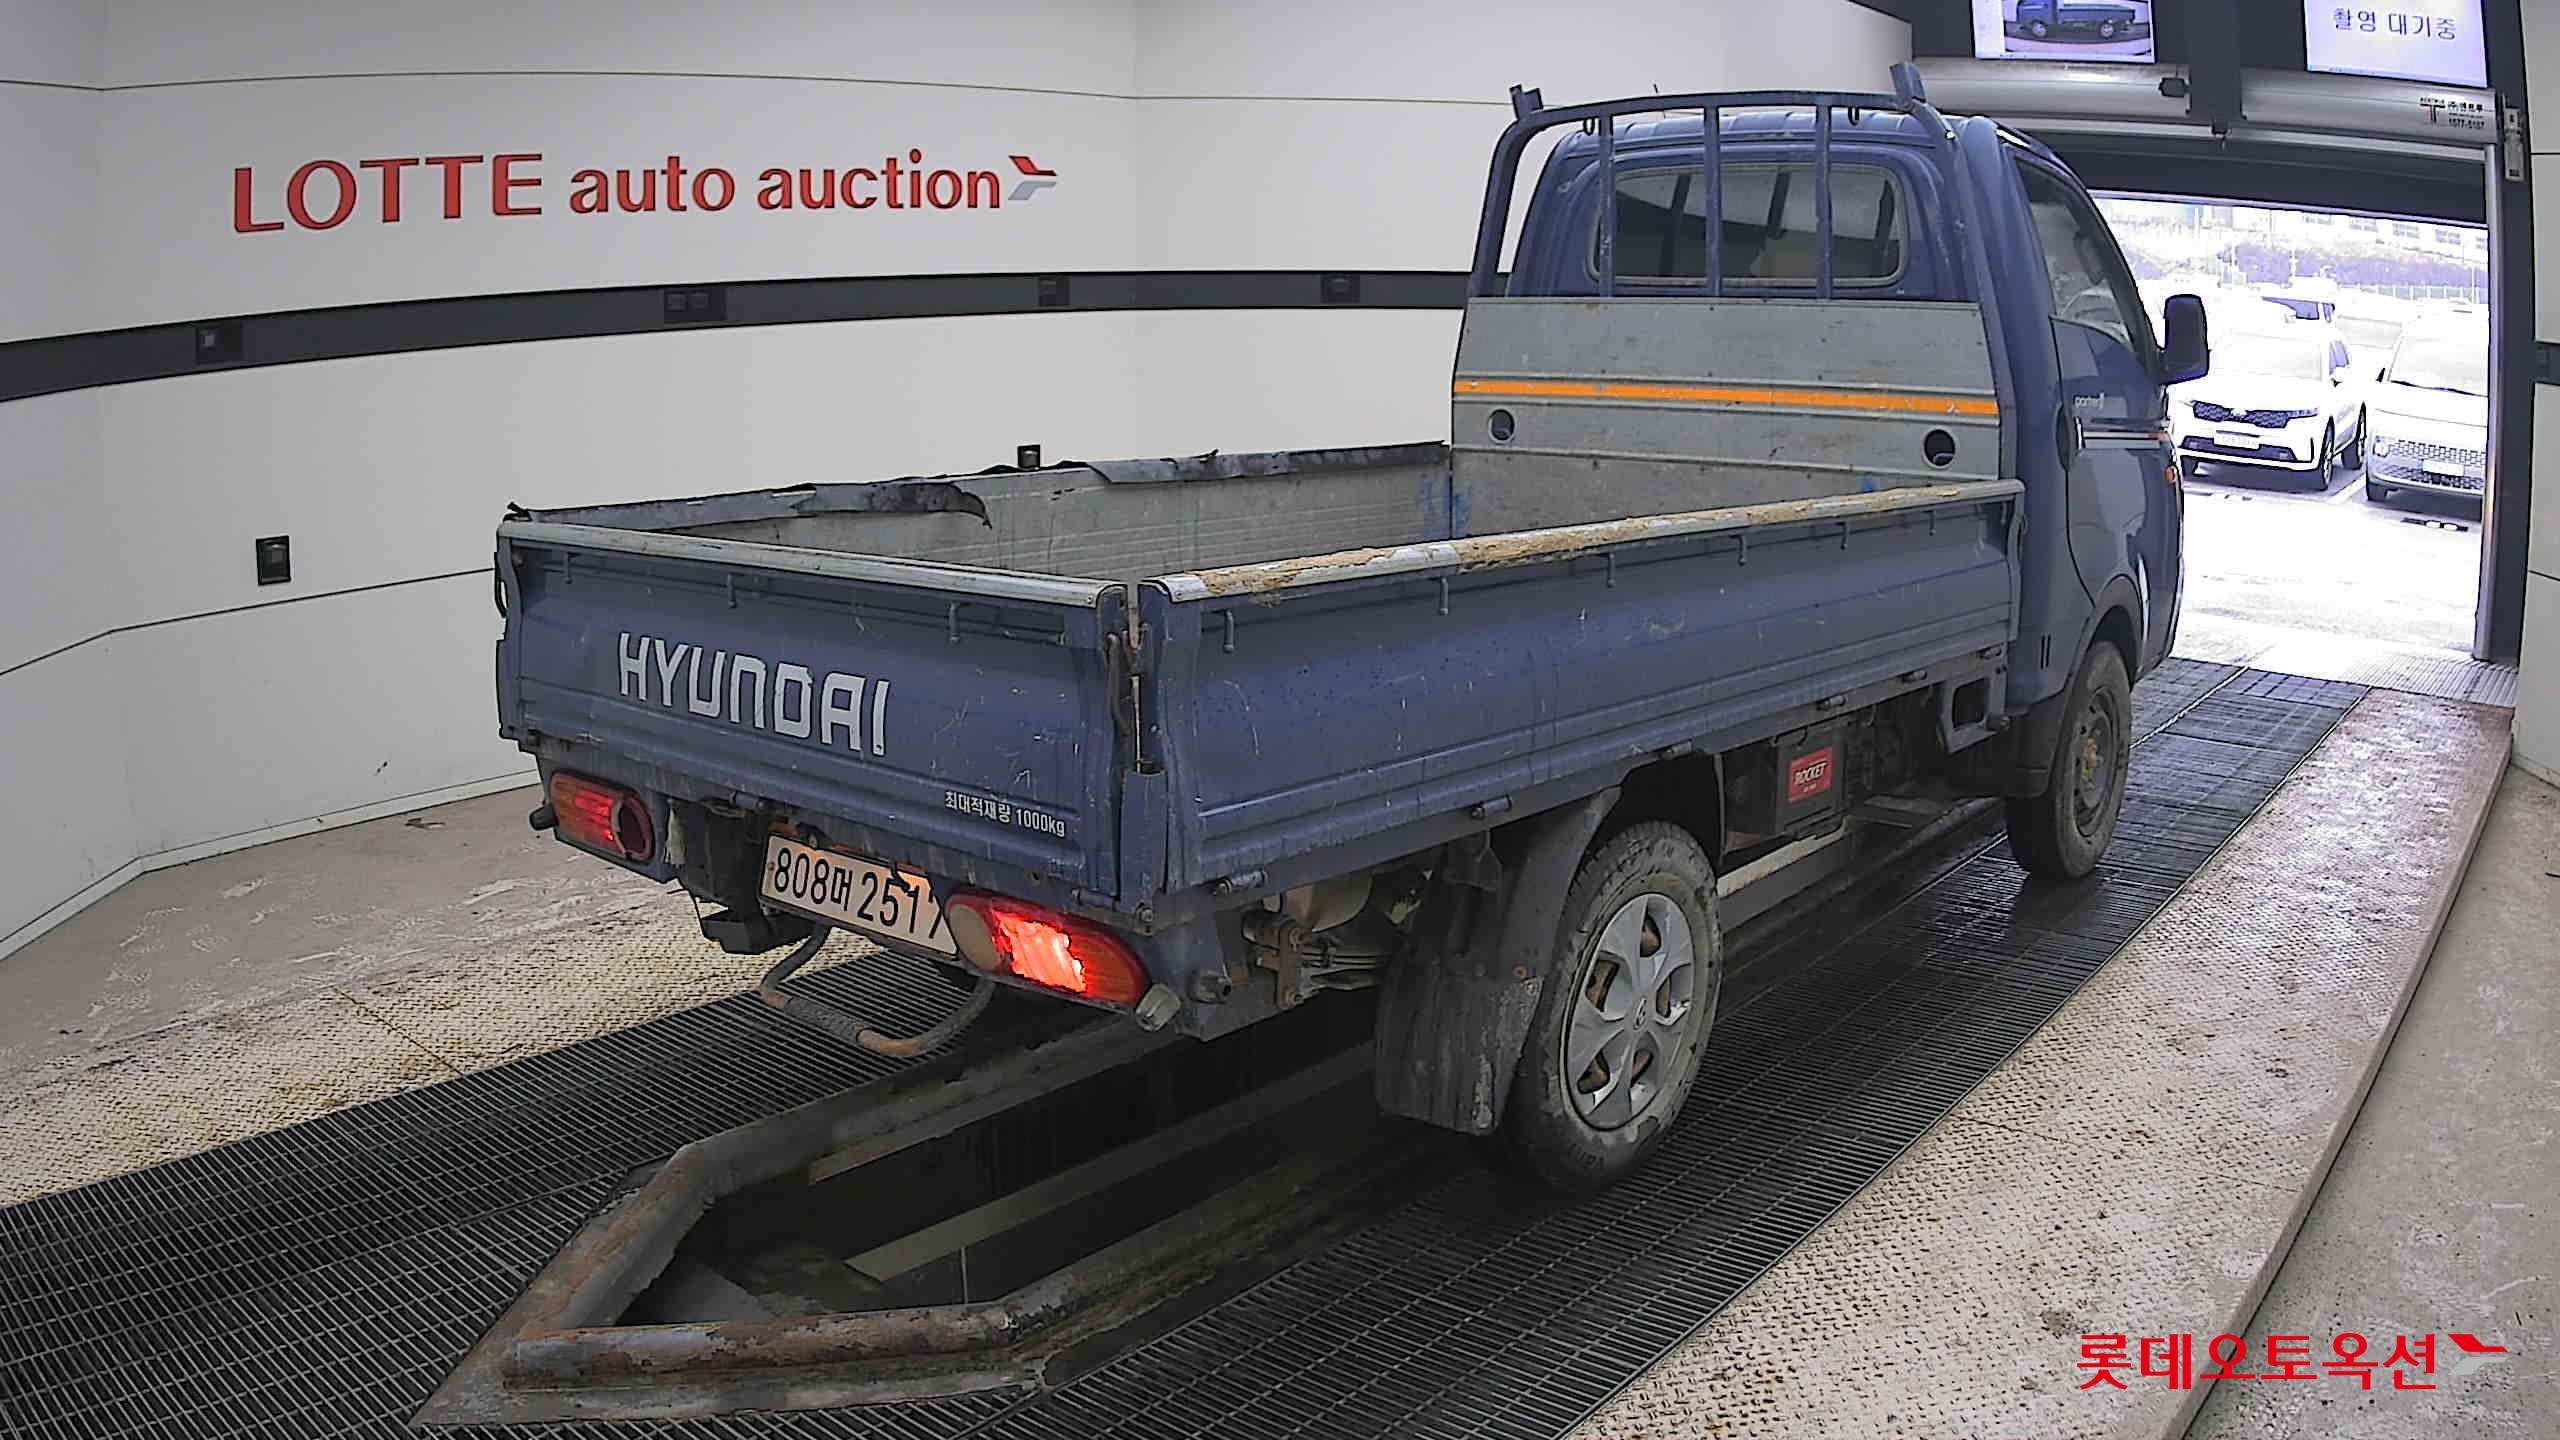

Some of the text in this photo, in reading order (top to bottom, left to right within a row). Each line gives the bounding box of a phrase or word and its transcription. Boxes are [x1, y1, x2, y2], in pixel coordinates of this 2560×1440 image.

[2332, 7, 2457, 41] 촬영 대기중
[233, 147, 1002, 233] LOTTE auto auction
[618, 631, 890, 757] HYUNDAI
[945, 790, 1066, 838] 최대적재량 1000kg
